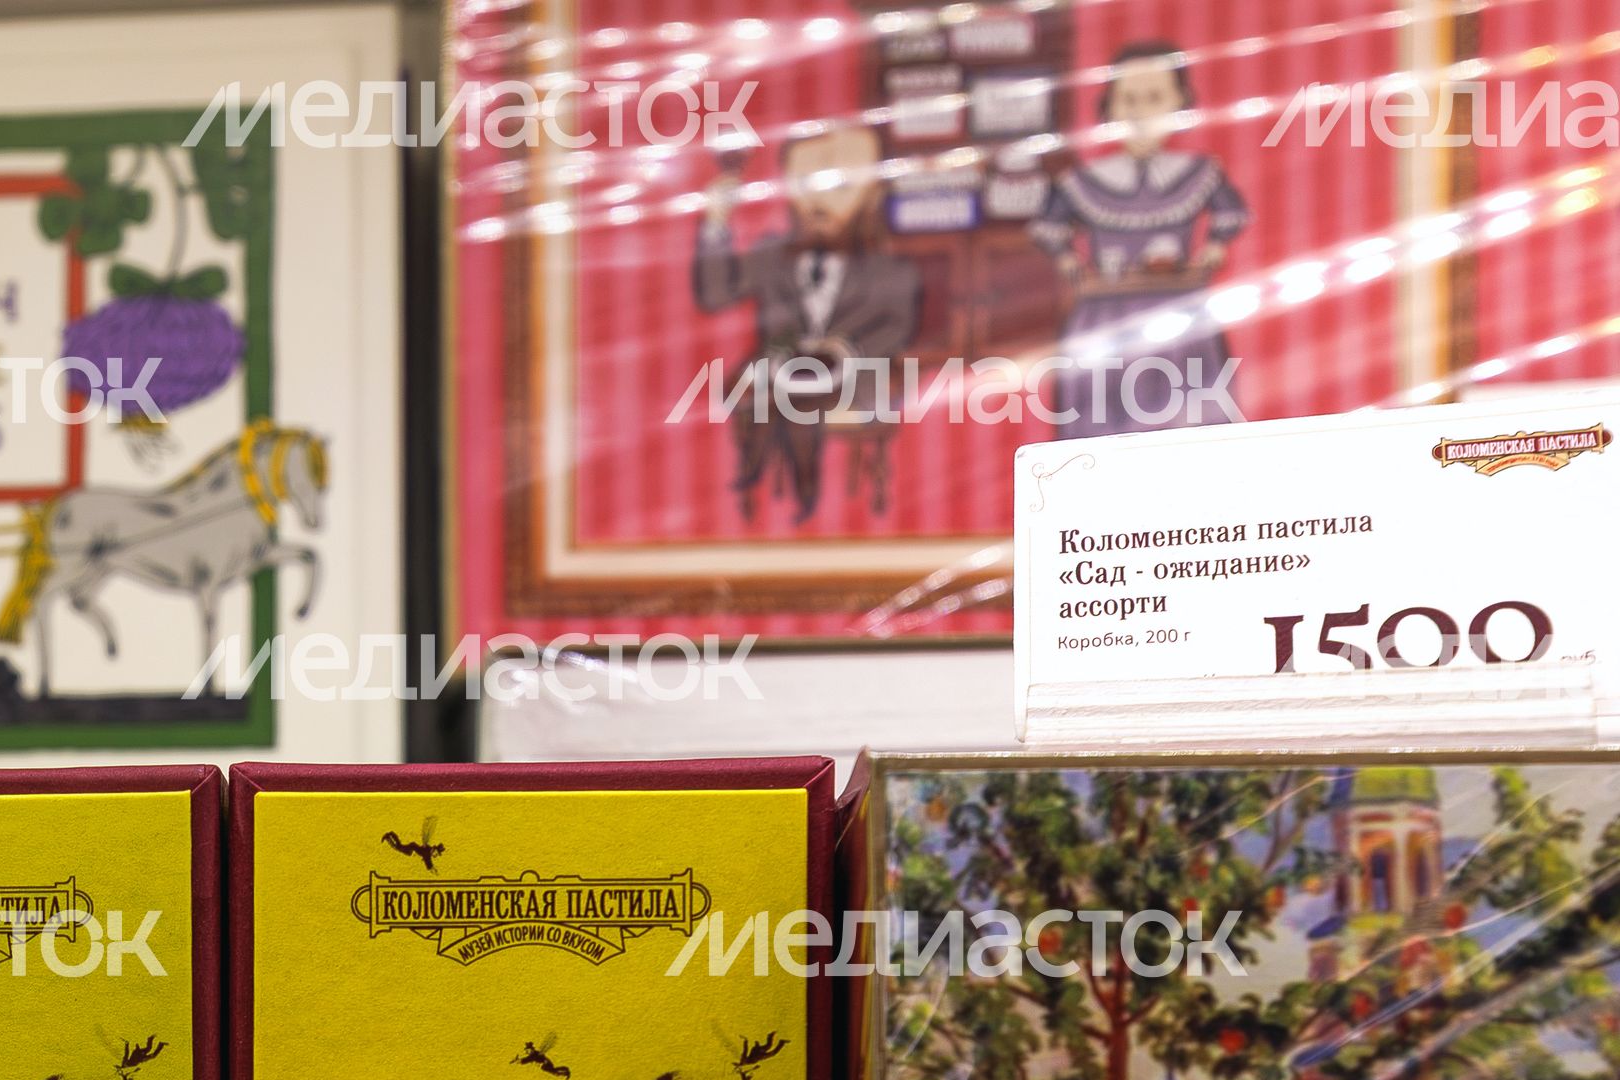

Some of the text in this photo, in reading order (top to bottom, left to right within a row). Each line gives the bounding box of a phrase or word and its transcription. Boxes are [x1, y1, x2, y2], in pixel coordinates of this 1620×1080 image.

[1447, 432, 1597, 461] КОЛОМЕНСКАЯ ПАСТИЛА
[1059, 514, 1373, 554] Коломенская пастила
[1059, 561, 1127, 587] «Сад
[1153, 553, 1311, 581] ожидание»
[1059, 594, 1168, 620] ассорти
[1058, 631, 1140, 651] Коробка,
[1146, 629, 1178, 646] 200
[1264, 600, 1554, 674] 1500
[382, 886, 680, 921] КОЛОМЕНСКАЯ ПАСТИЛА
[457, 926, 606, 962] МУЗЕЙ ИСТОРИИ СО ВКУСОМ
